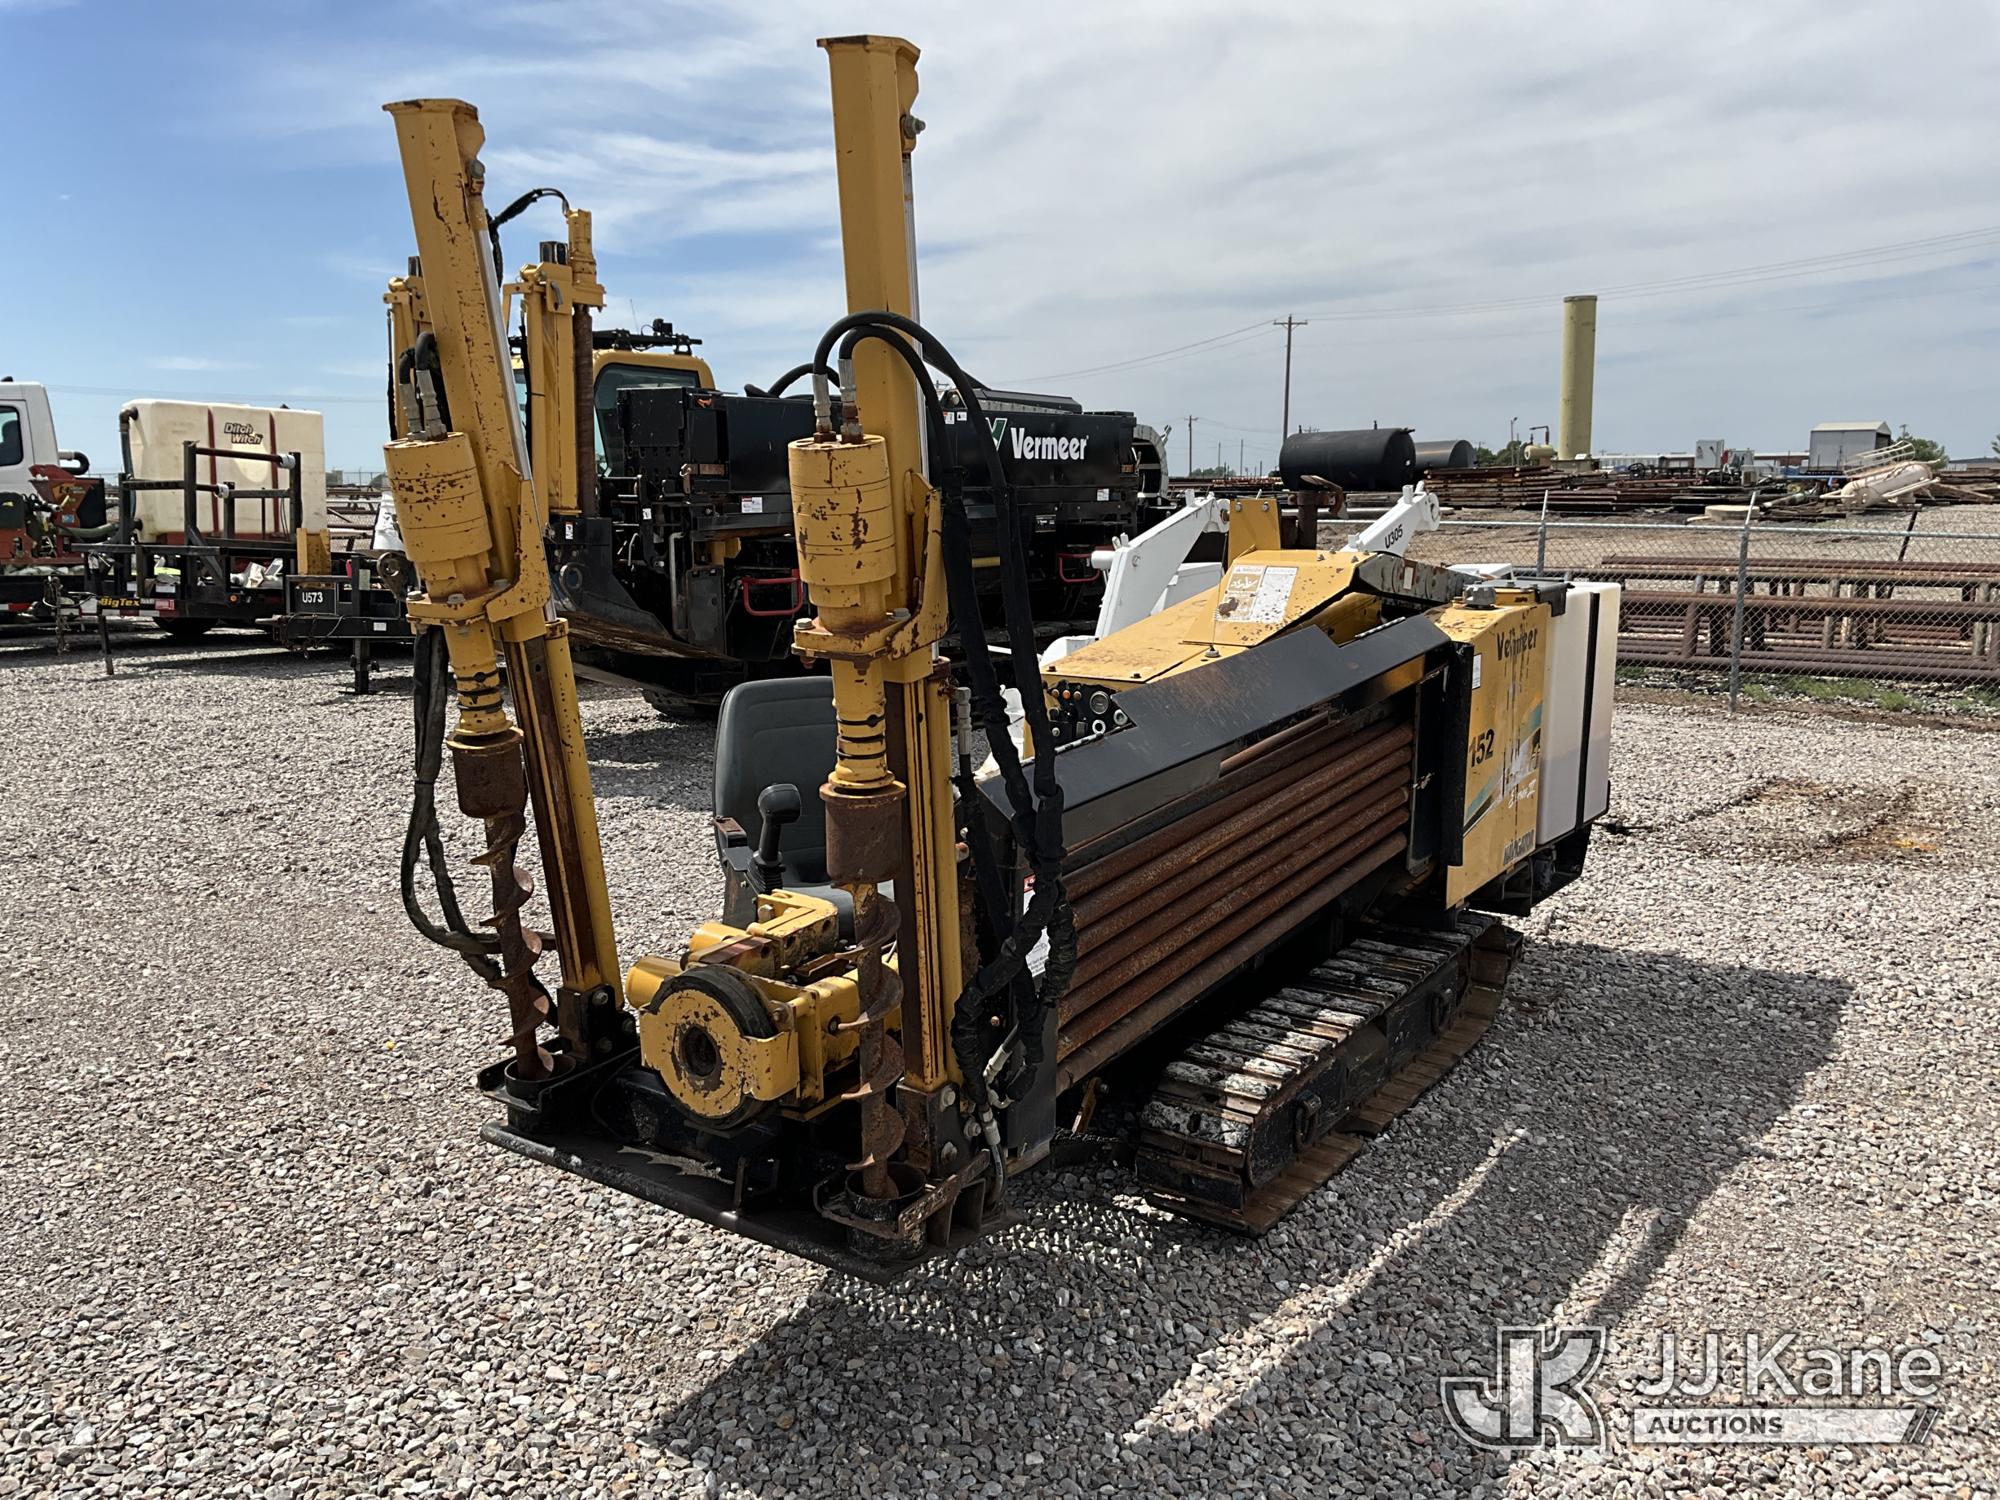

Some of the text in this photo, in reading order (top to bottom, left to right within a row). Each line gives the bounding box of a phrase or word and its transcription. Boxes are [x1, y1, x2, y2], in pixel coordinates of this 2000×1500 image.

[224, 422, 253, 434] Ditch
[231, 433, 263, 444] Witch
[1010, 427, 1089, 460] Vermeer
[1384, 523, 1403, 549] U305
[302, 591, 324, 604] U573
[1496, 628, 1538, 661] Vermeer
